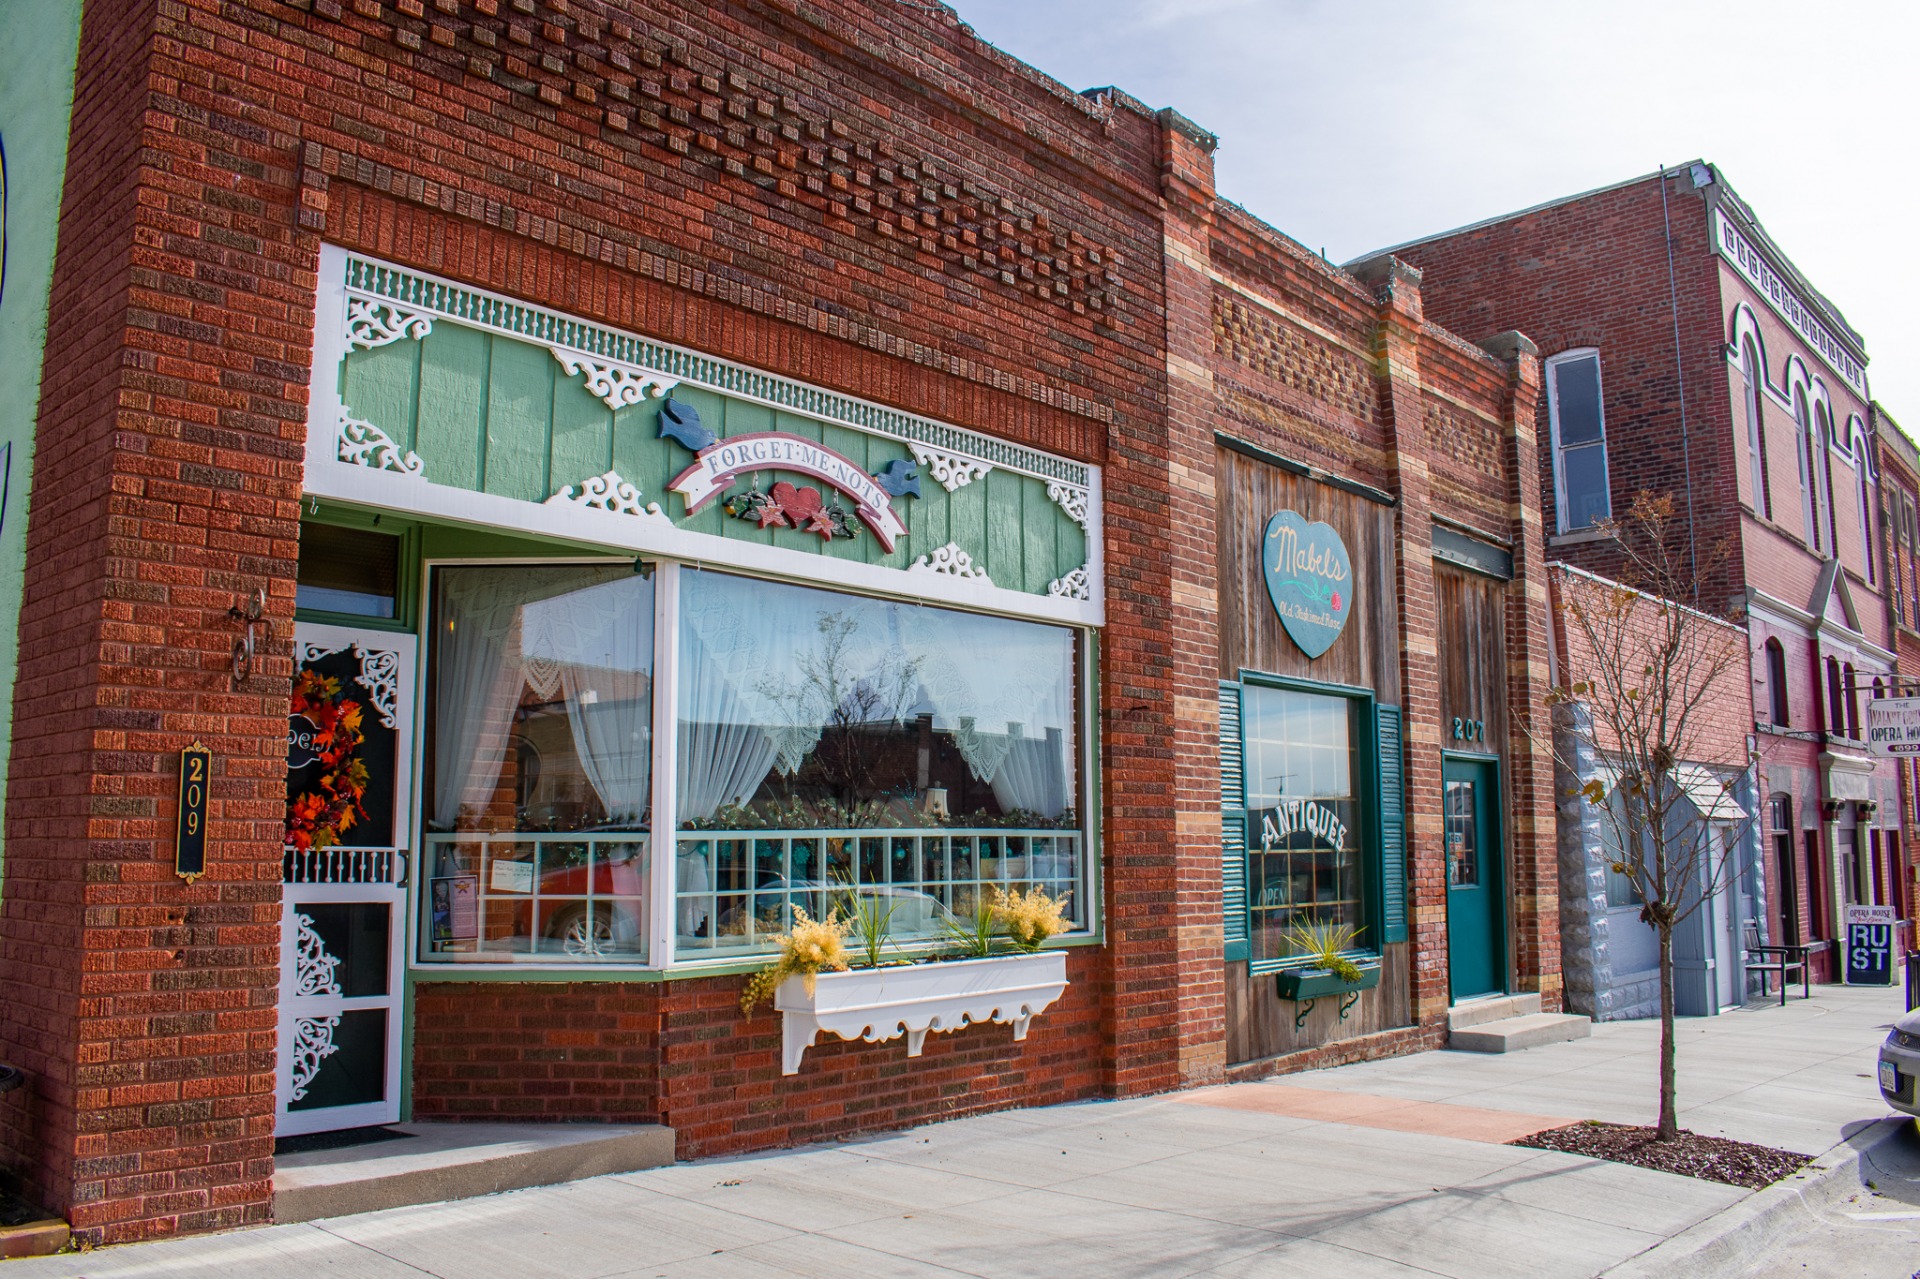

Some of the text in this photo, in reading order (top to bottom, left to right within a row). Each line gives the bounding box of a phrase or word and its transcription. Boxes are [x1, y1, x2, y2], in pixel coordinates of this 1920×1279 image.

[1269, 526, 1348, 581] Mabel's
[1453, 716, 1484, 742] 207
[1871, 726, 1920, 742] OPERA HO
[188, 757, 203, 836] 209
[1261, 800, 1347, 855] ANTIQUES
[1257, 887, 1287, 907] OPEN
[1849, 909, 1891, 919] OPERA HOUSE
[1852, 925, 1888, 947] RU
[1851, 947, 1888, 970] ST
